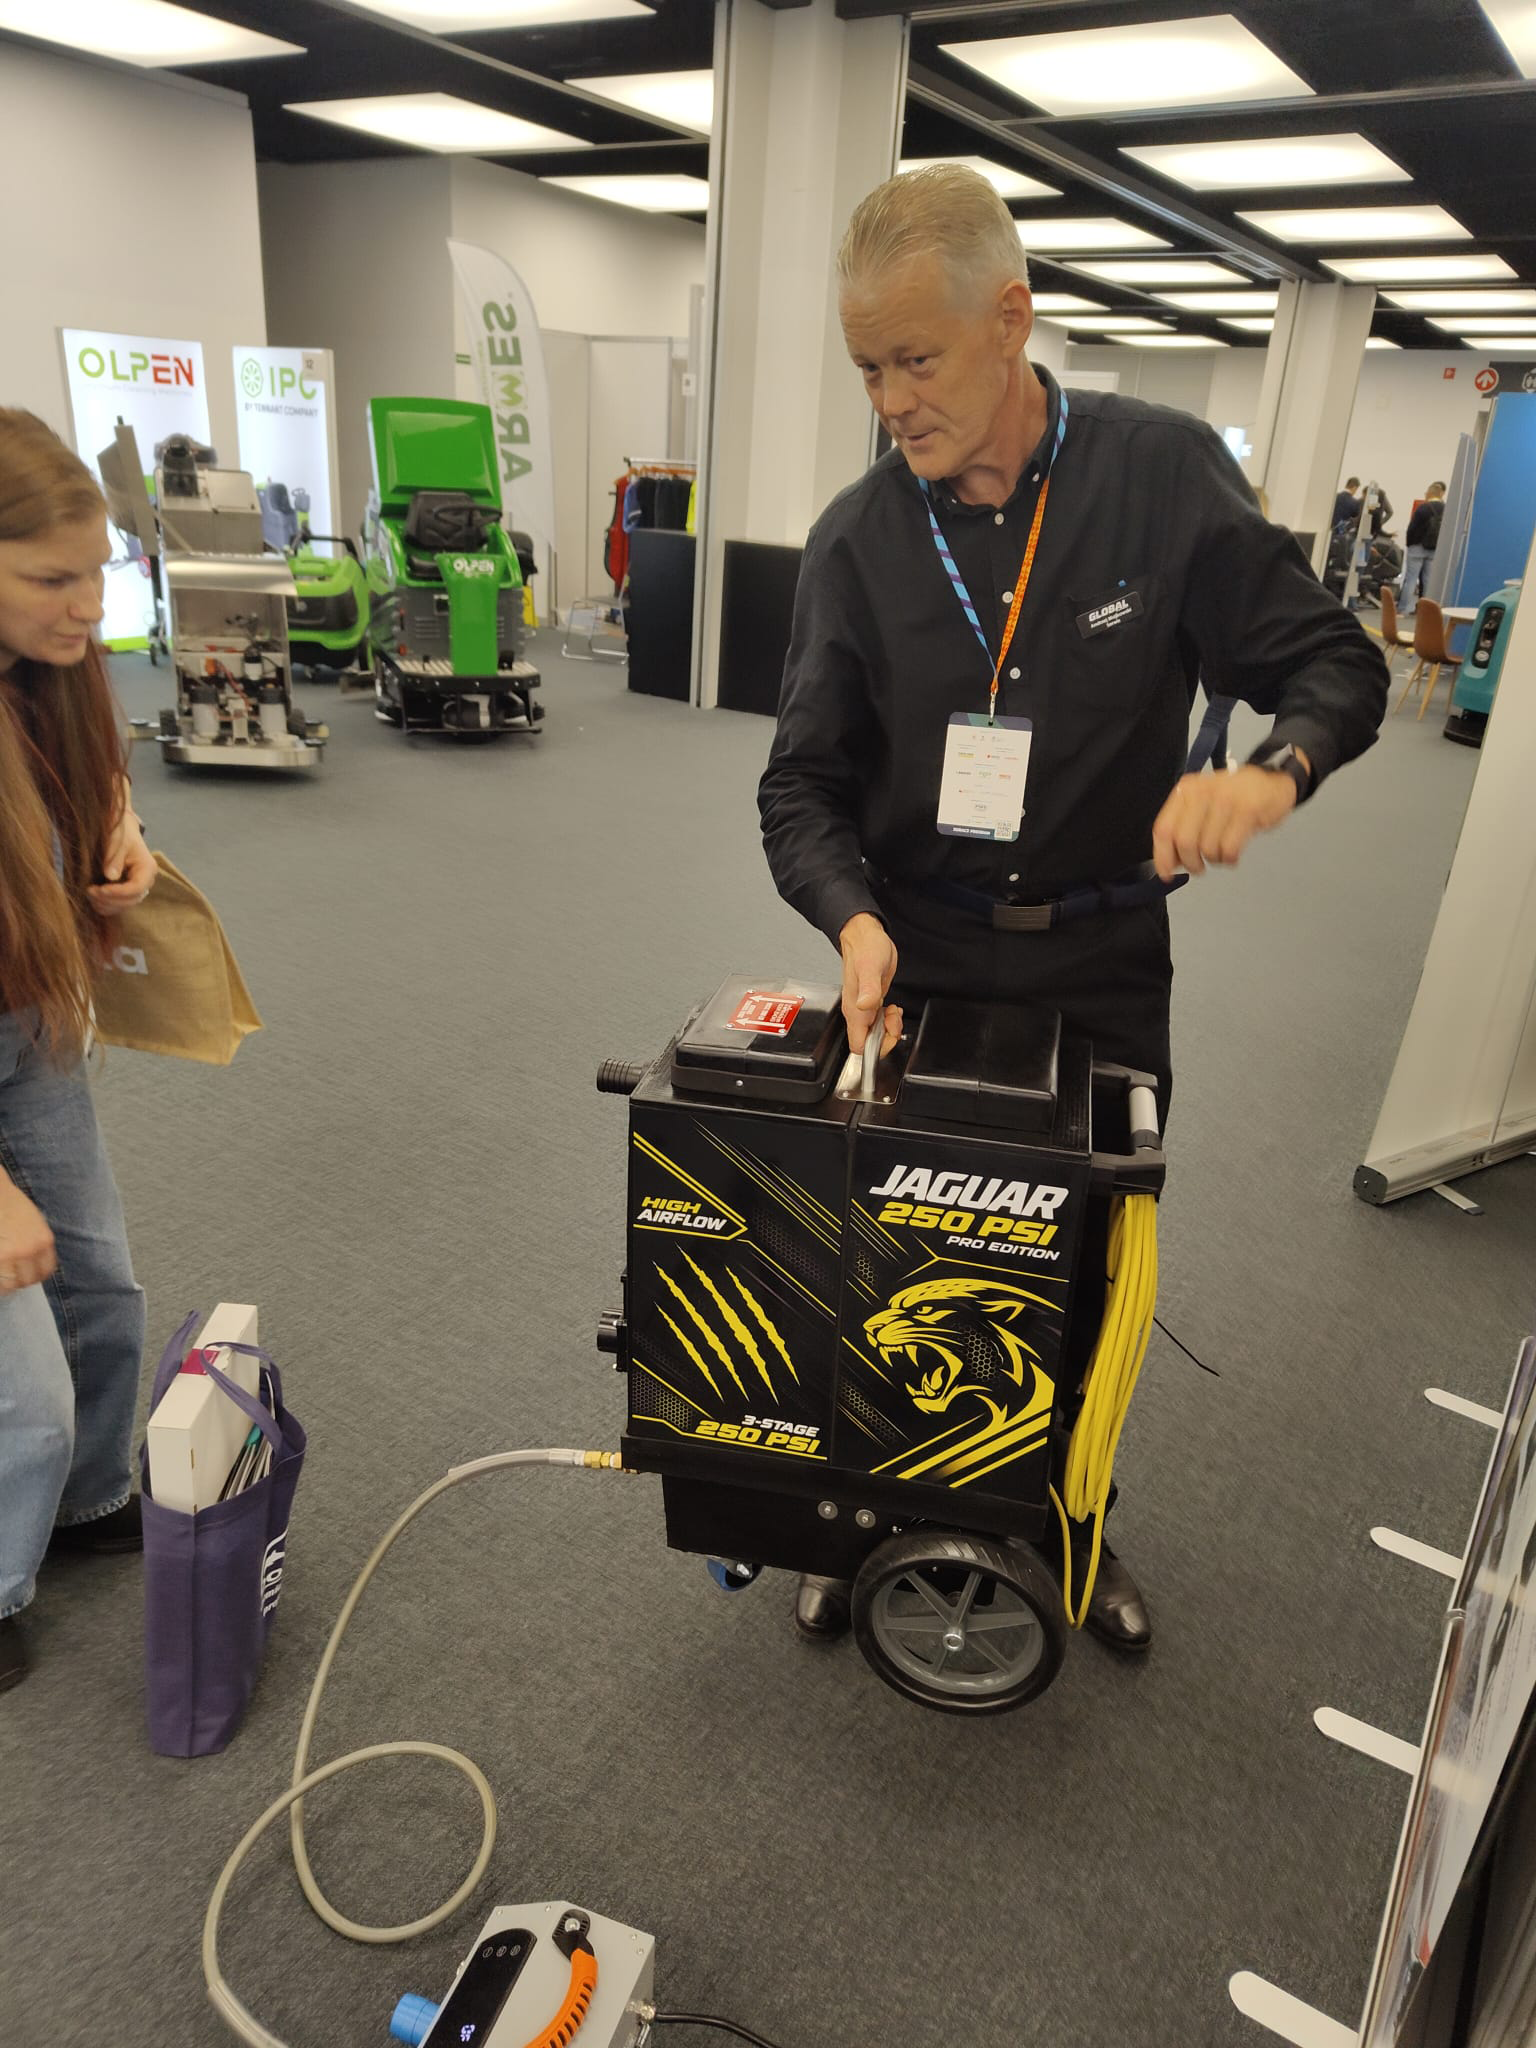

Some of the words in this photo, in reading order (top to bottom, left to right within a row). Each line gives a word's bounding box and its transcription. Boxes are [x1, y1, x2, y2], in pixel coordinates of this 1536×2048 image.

[78, 347, 195, 387] OLPEN
[269, 367, 317, 400] IPC
[1088, 599, 1129, 622] GLOBAL
[641, 1196, 702, 1214] HIGH
[869, 1164, 1069, 1220] JAGUAR
[636, 1208, 727, 1231] AIRFLOW
[878, 1201, 976, 1233] 250
[977, 1215, 1059, 1246] PSI
[946, 1235, 985, 1249] PRO
[987, 1242, 1060, 1261] EDITION
[695, 1420, 762, 1443] 250
[764, 1431, 821, 1453] PSI
[741, 1414, 820, 1437] 3-STAGE
